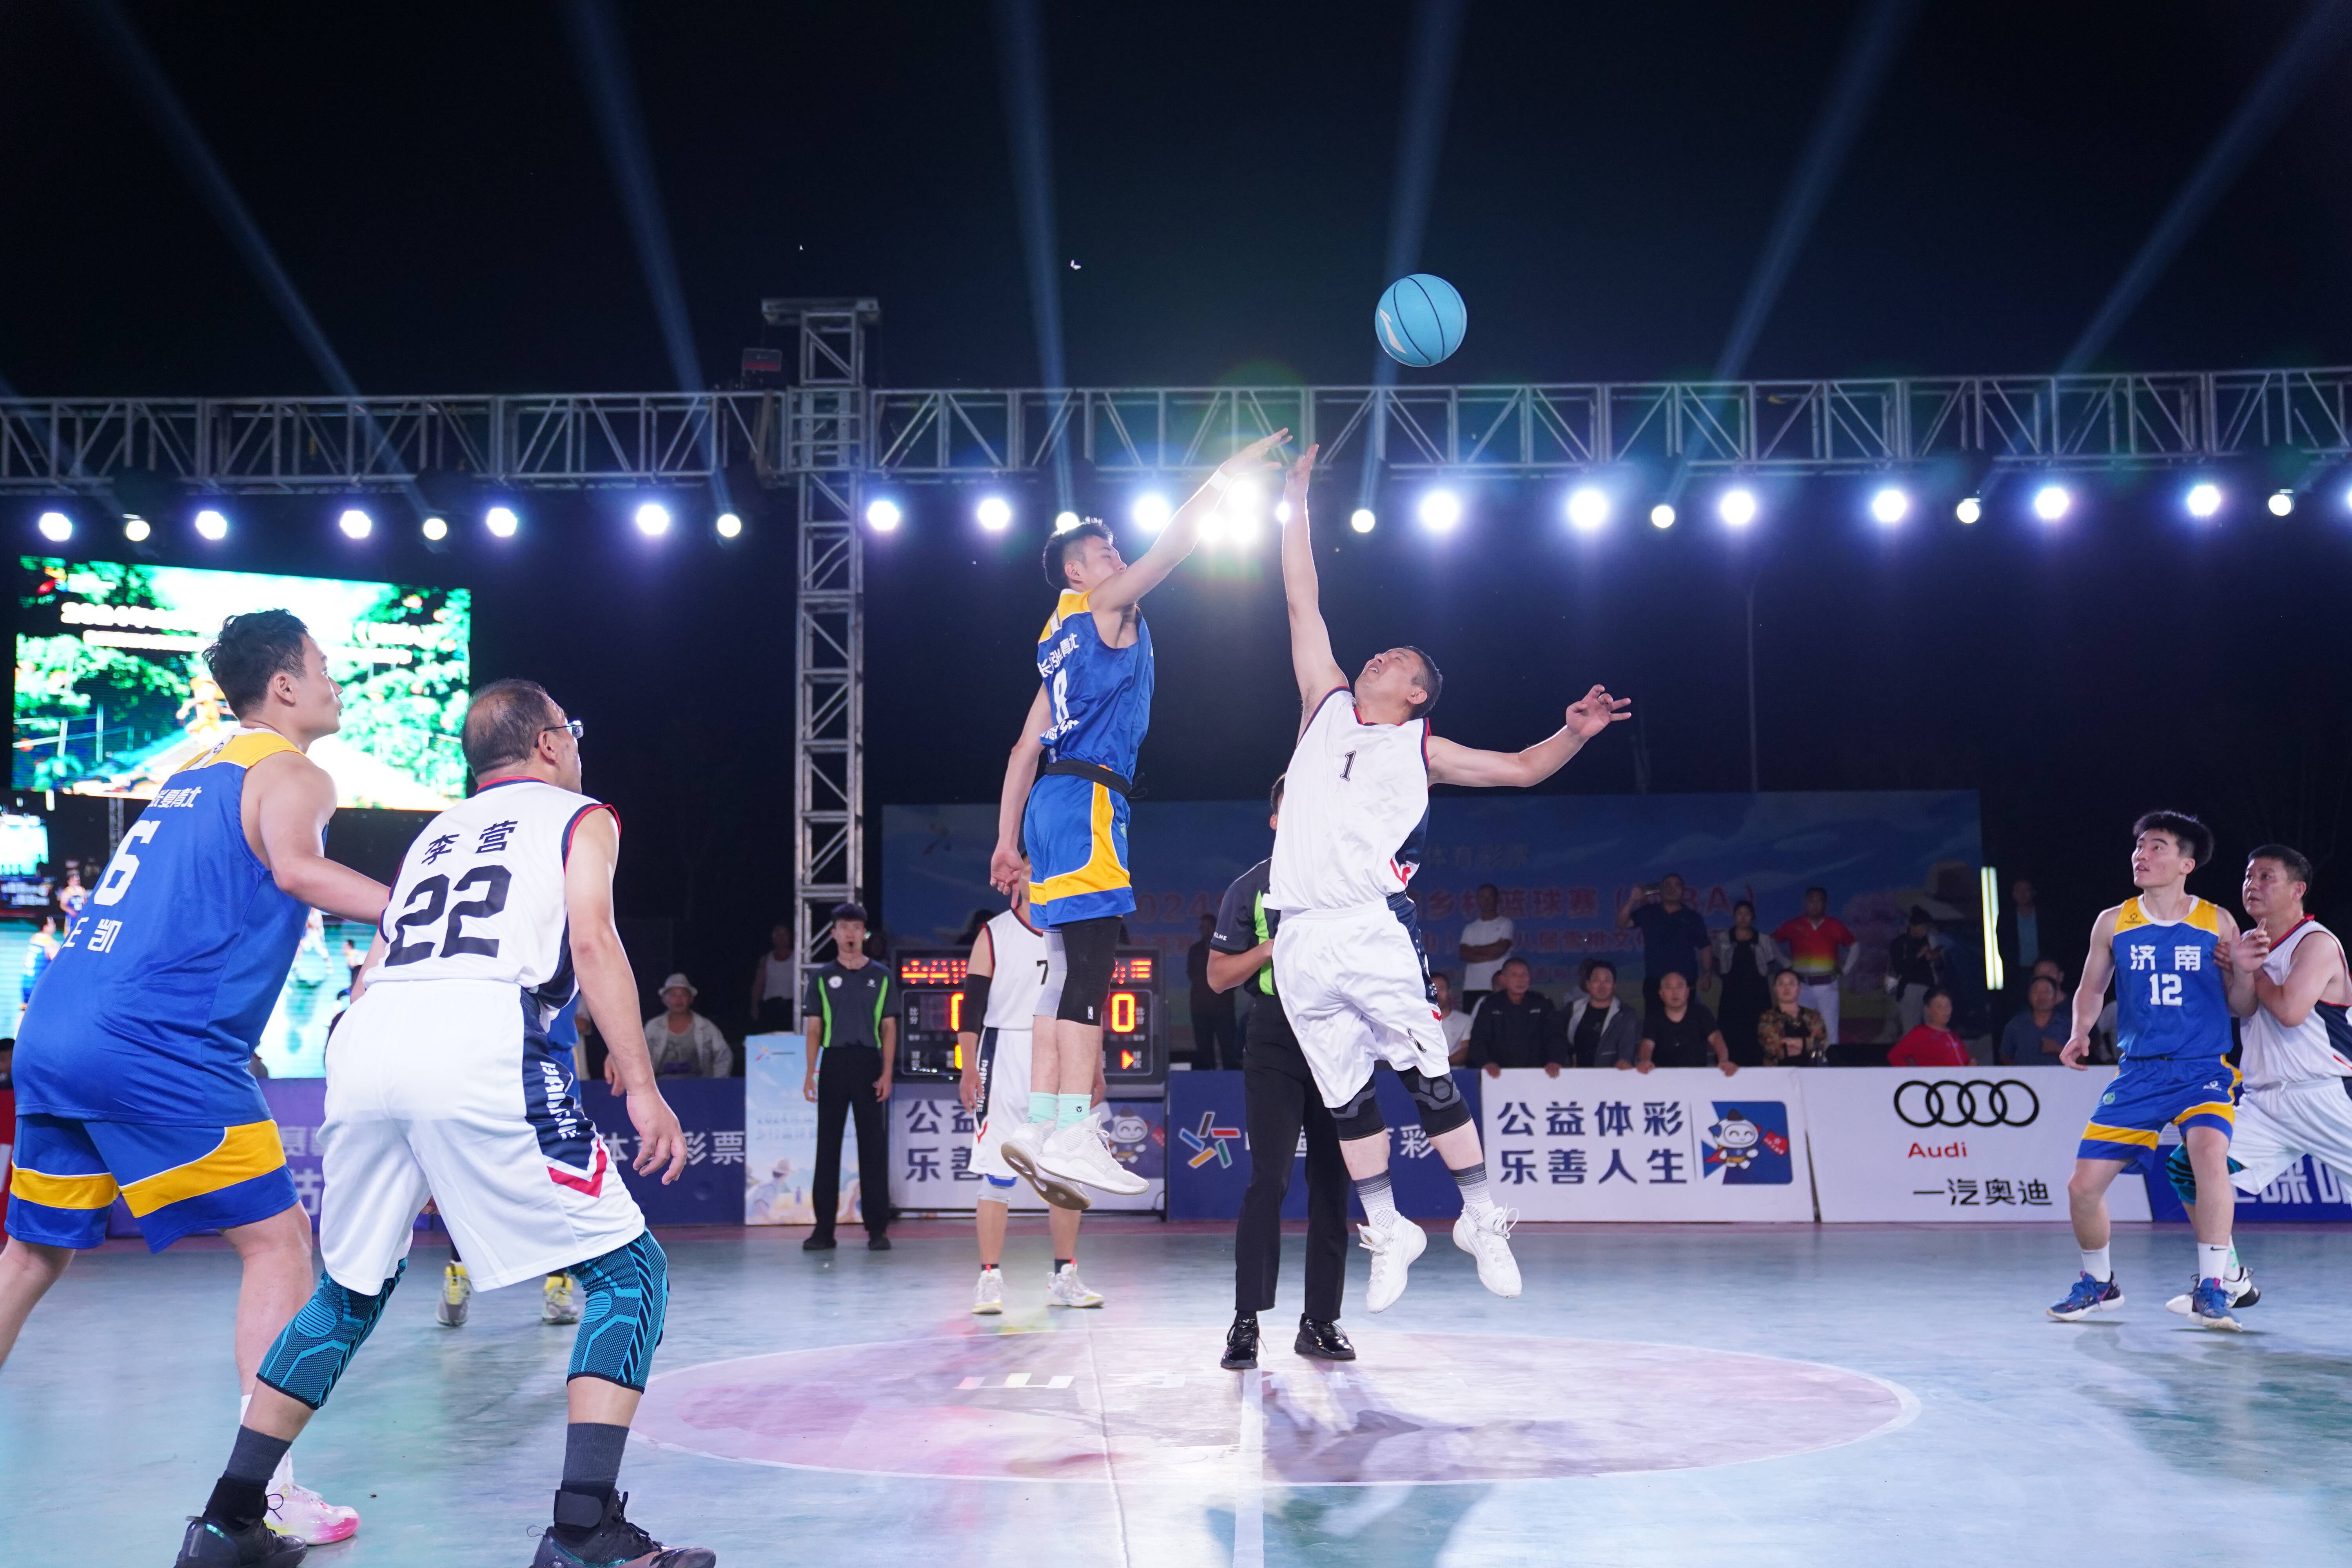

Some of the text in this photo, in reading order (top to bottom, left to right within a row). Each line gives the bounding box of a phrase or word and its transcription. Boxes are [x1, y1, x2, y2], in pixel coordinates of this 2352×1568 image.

[1053, 668, 1069, 726] 8
[1340, 750, 1356, 782] 1
[421, 820, 518, 866] 李营
[94, 820, 161, 906] 6
[385, 865, 512, 968] 22
[1036, 960, 1049, 985] 7
[2130, 945, 2201, 971] 济南
[2149, 974, 2183, 1006] 12
[1111, 993, 1136, 1033] 0
[1497, 1100, 1684, 1136] 公益体彩
[1499, 1148, 1687, 1185] 乐善人生
[1907, 1142, 1967, 1158] Audi
[1913, 1178, 2053, 1205] 一汽奥迪
